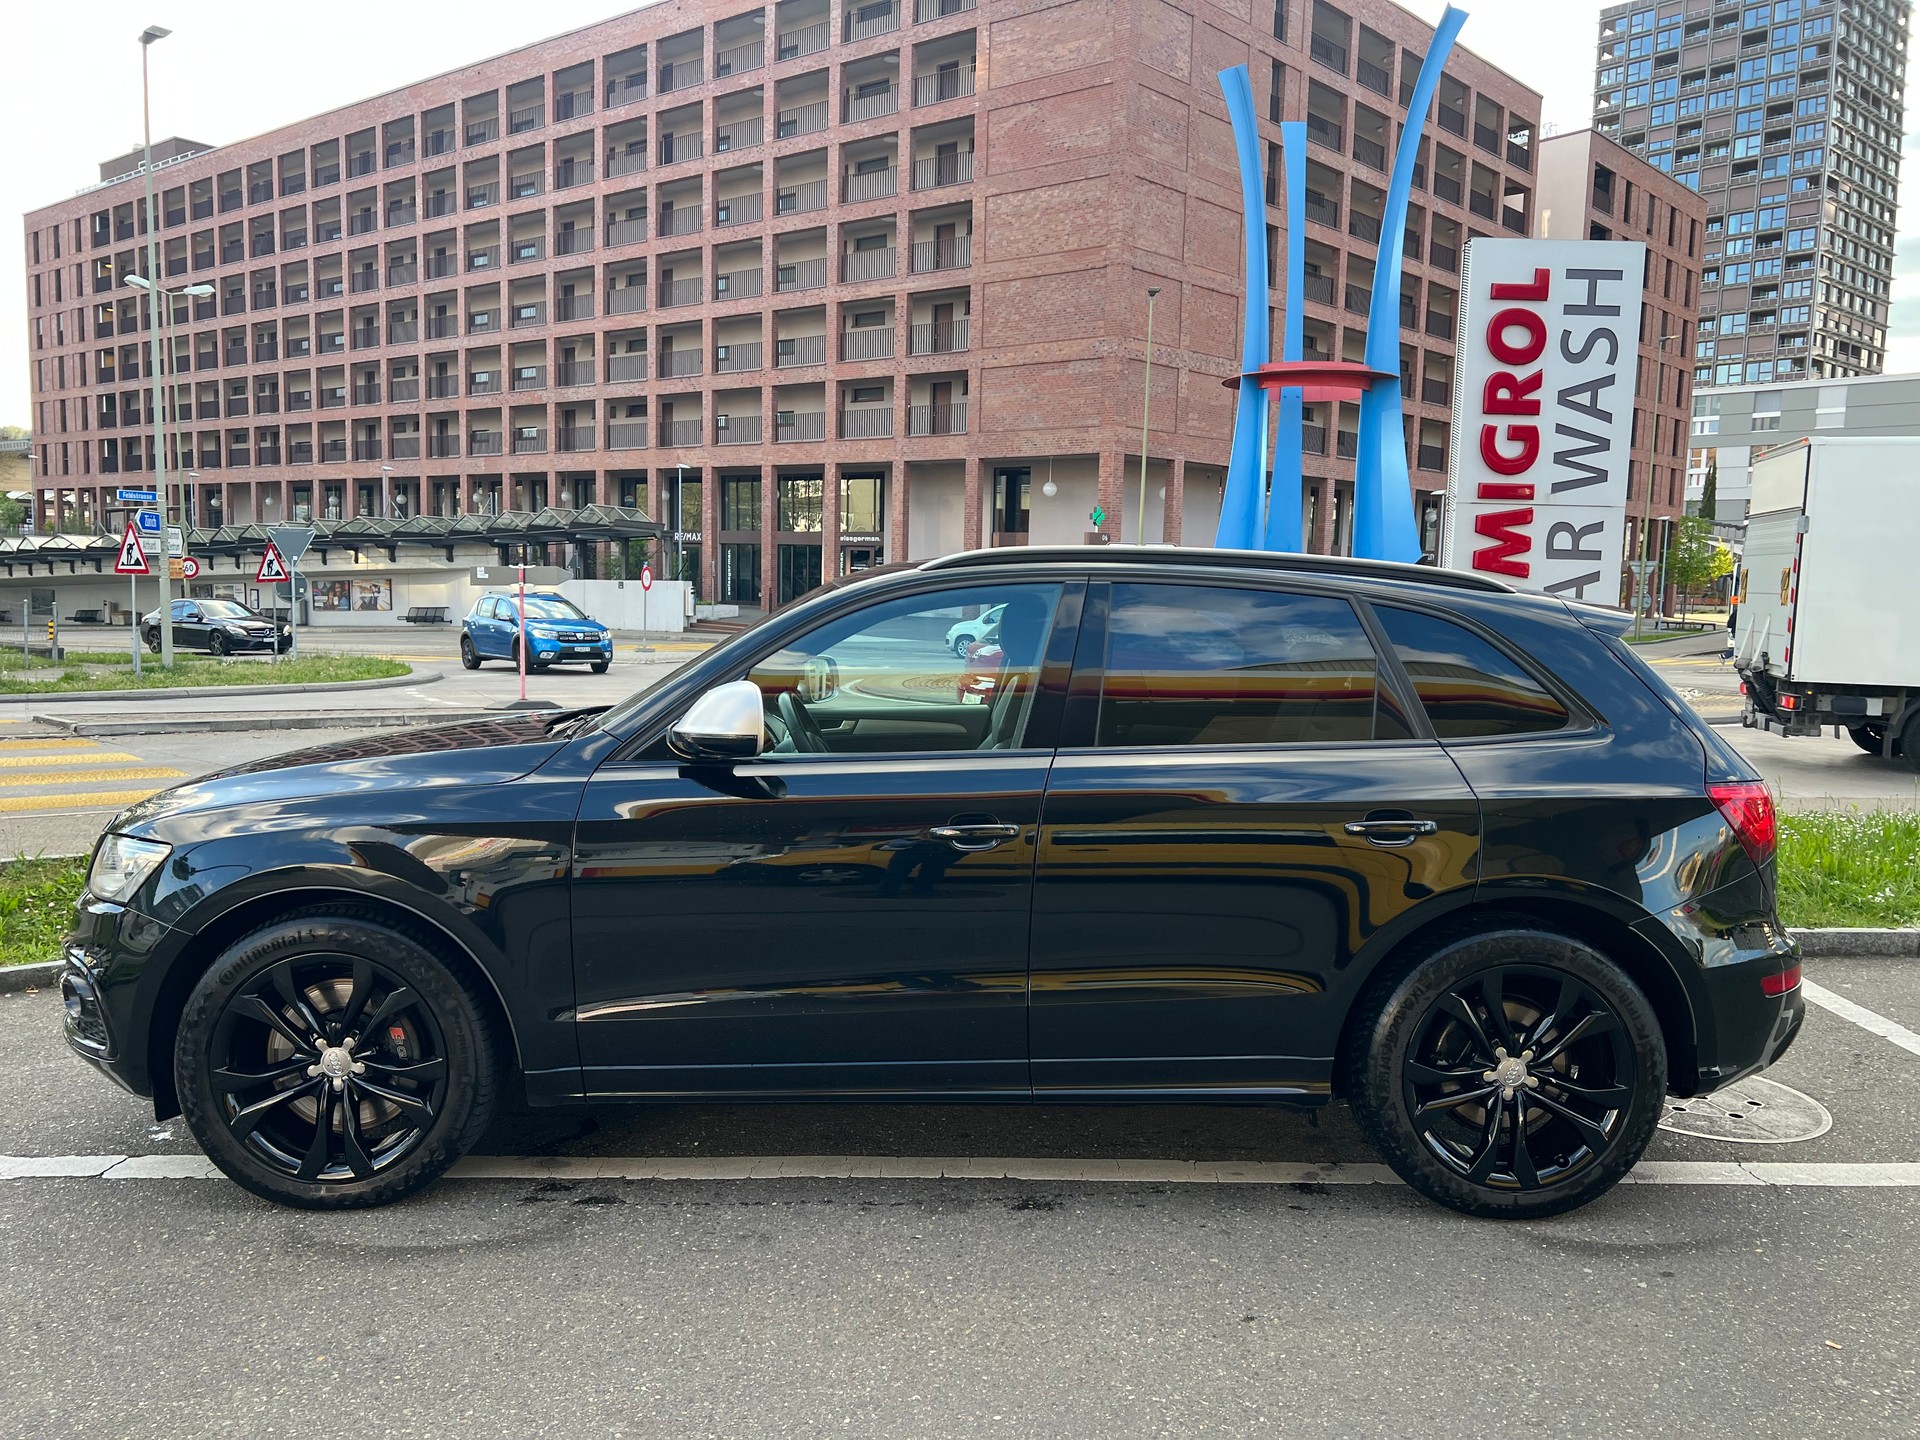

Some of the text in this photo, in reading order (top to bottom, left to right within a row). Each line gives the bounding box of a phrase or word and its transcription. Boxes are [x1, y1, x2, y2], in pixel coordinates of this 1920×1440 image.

[1472, 267, 1551, 579] MIGROL
[1544, 268, 1624, 599] AR WASH
[122, 491, 153, 500] Feldstrasse
[674, 532, 702, 541] RE/MAX
[840, 535, 881, 543] wissgerman.
[184, 564, 194, 573] 60
[218, 930, 303, 986] Continental
